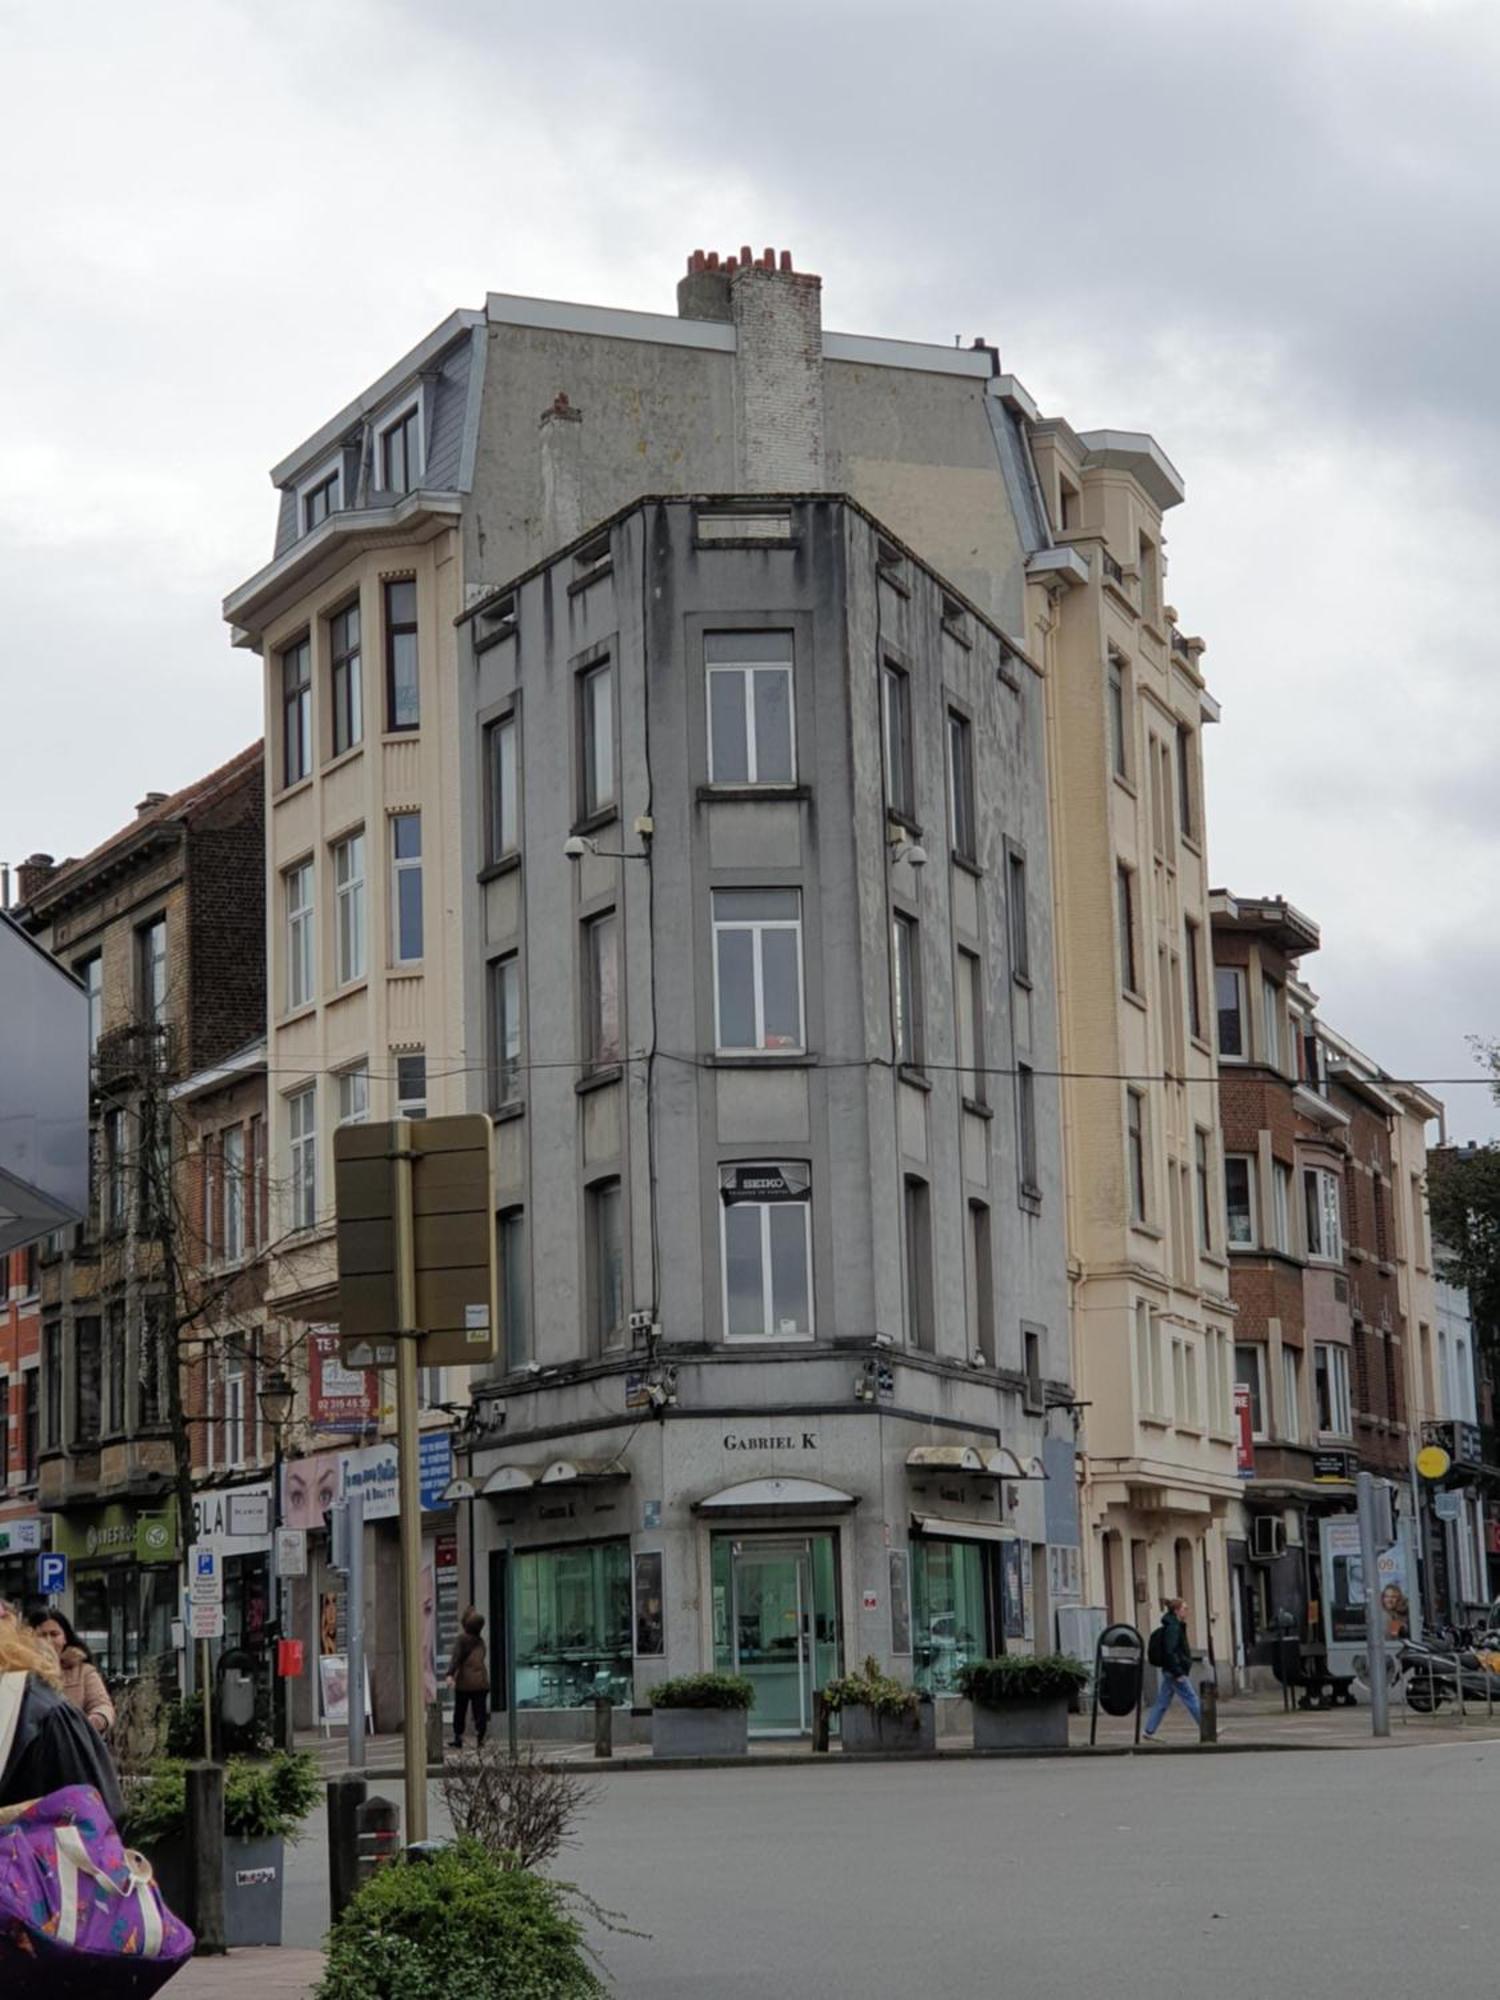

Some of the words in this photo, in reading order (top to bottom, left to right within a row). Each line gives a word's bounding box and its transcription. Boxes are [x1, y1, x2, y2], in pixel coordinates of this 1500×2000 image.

[723, 1434, 796, 1451] GABRIEL
[801, 1433, 817, 1449] K
[43, 1558, 64, 1587] P
